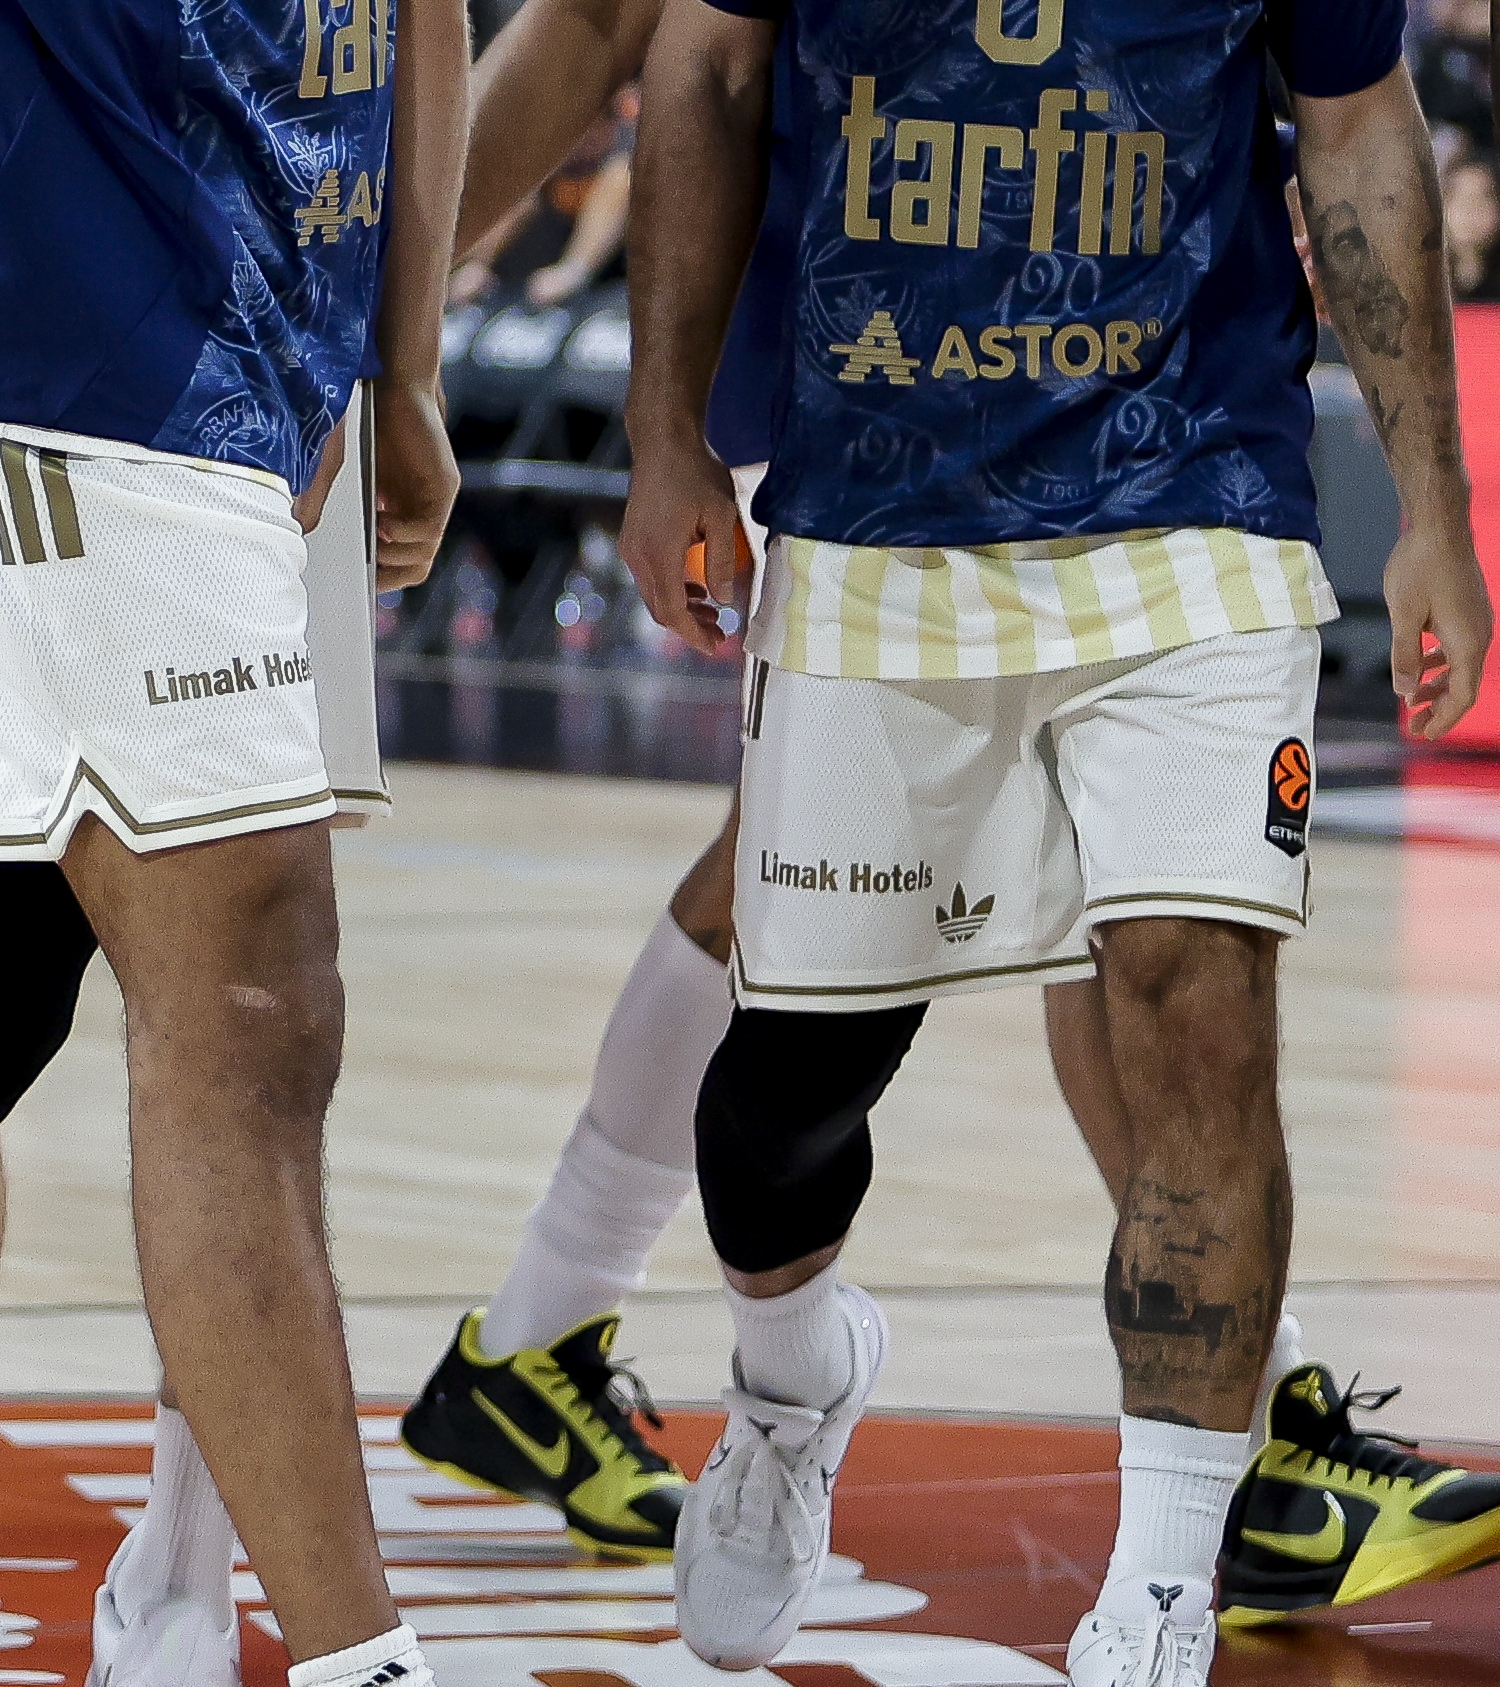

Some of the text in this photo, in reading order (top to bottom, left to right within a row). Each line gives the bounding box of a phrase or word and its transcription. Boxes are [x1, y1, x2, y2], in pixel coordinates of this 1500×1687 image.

[841, 76, 1165, 257] tarfin
[144, 656, 258, 706] Limak
[760, 849, 933, 895] Limak Hotels
